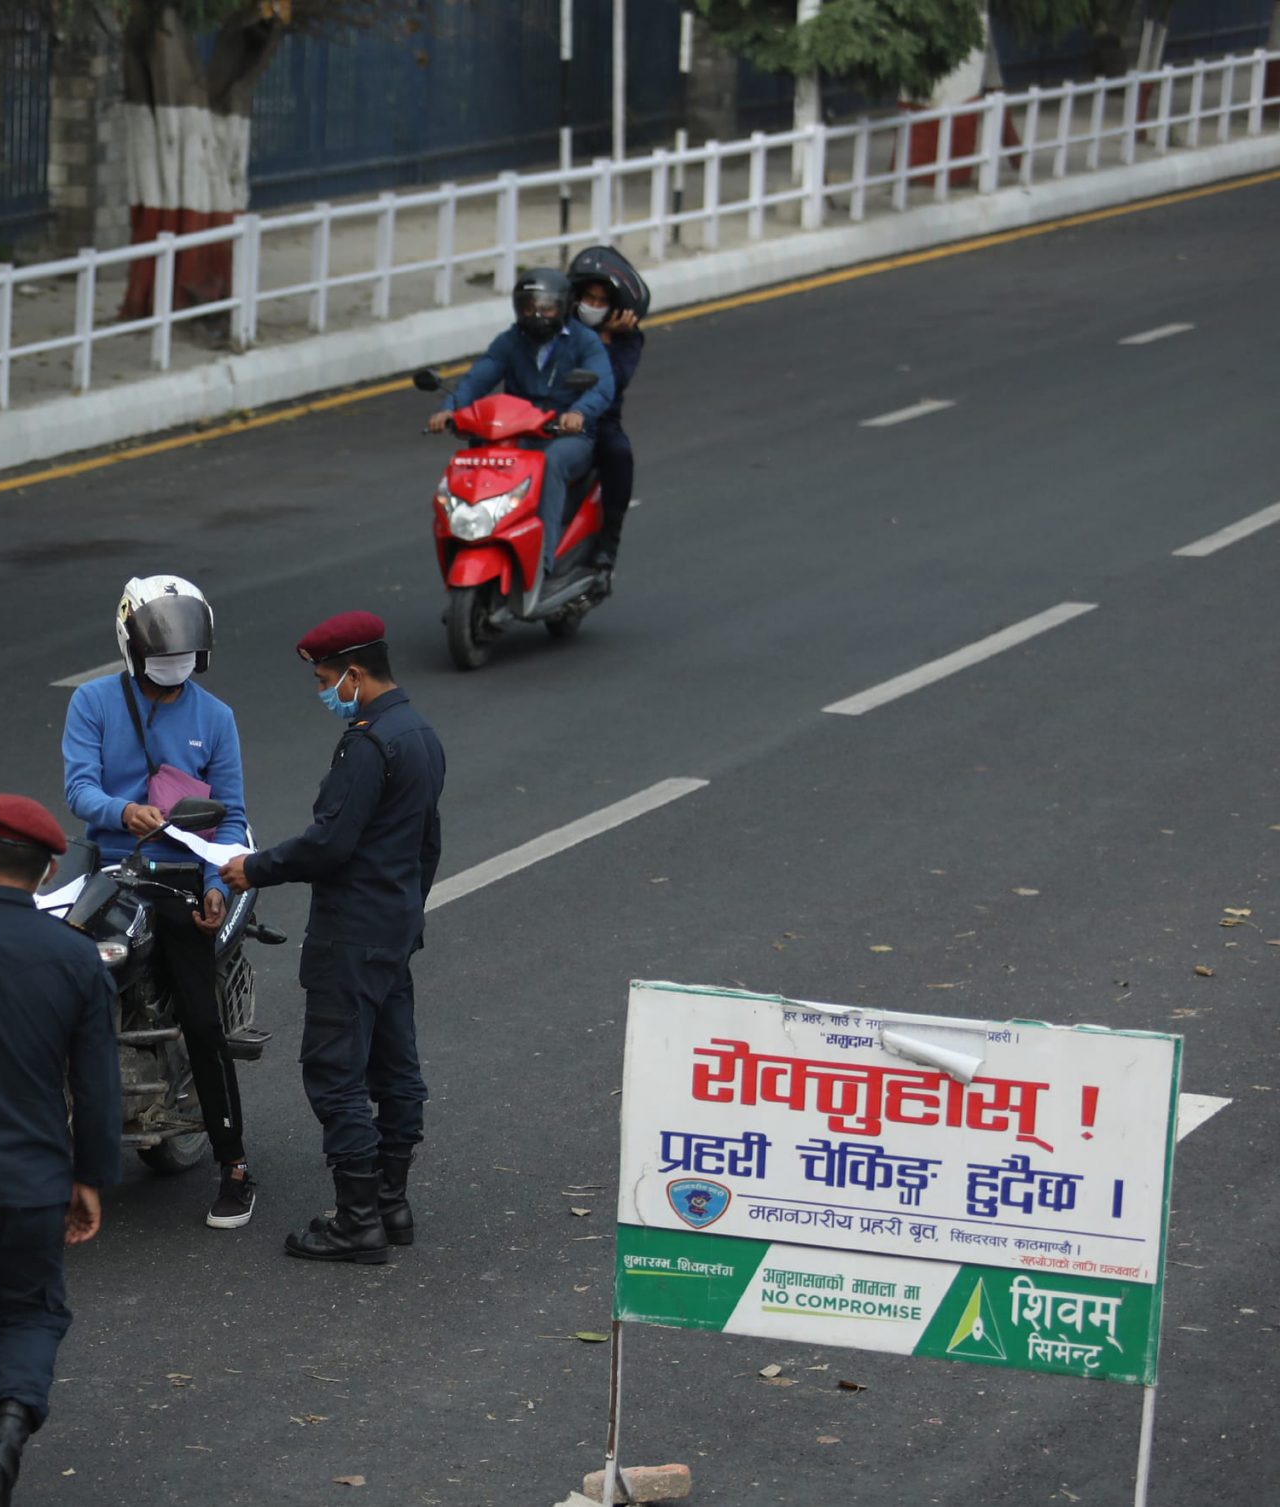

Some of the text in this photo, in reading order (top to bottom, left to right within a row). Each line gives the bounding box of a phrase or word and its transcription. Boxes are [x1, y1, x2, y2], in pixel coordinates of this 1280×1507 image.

[658, 1130, 772, 1179] प्रहरी
[748, 1204, 854, 1229] महानगरीय
[860, 1216, 903, 1236] प्रहरी
[1020, 1255, 1069, 1269] सहयोगको
[1072, 1260, 1096, 1273] लागि
[762, 1267, 922, 1301] अनुशासनको मामला मा
[761, 1289, 923, 1320] NO COMPROMISE
[1008, 1275, 1123, 1353] शिवम्
[1027, 1332, 1103, 1368] सिमेन्ट
